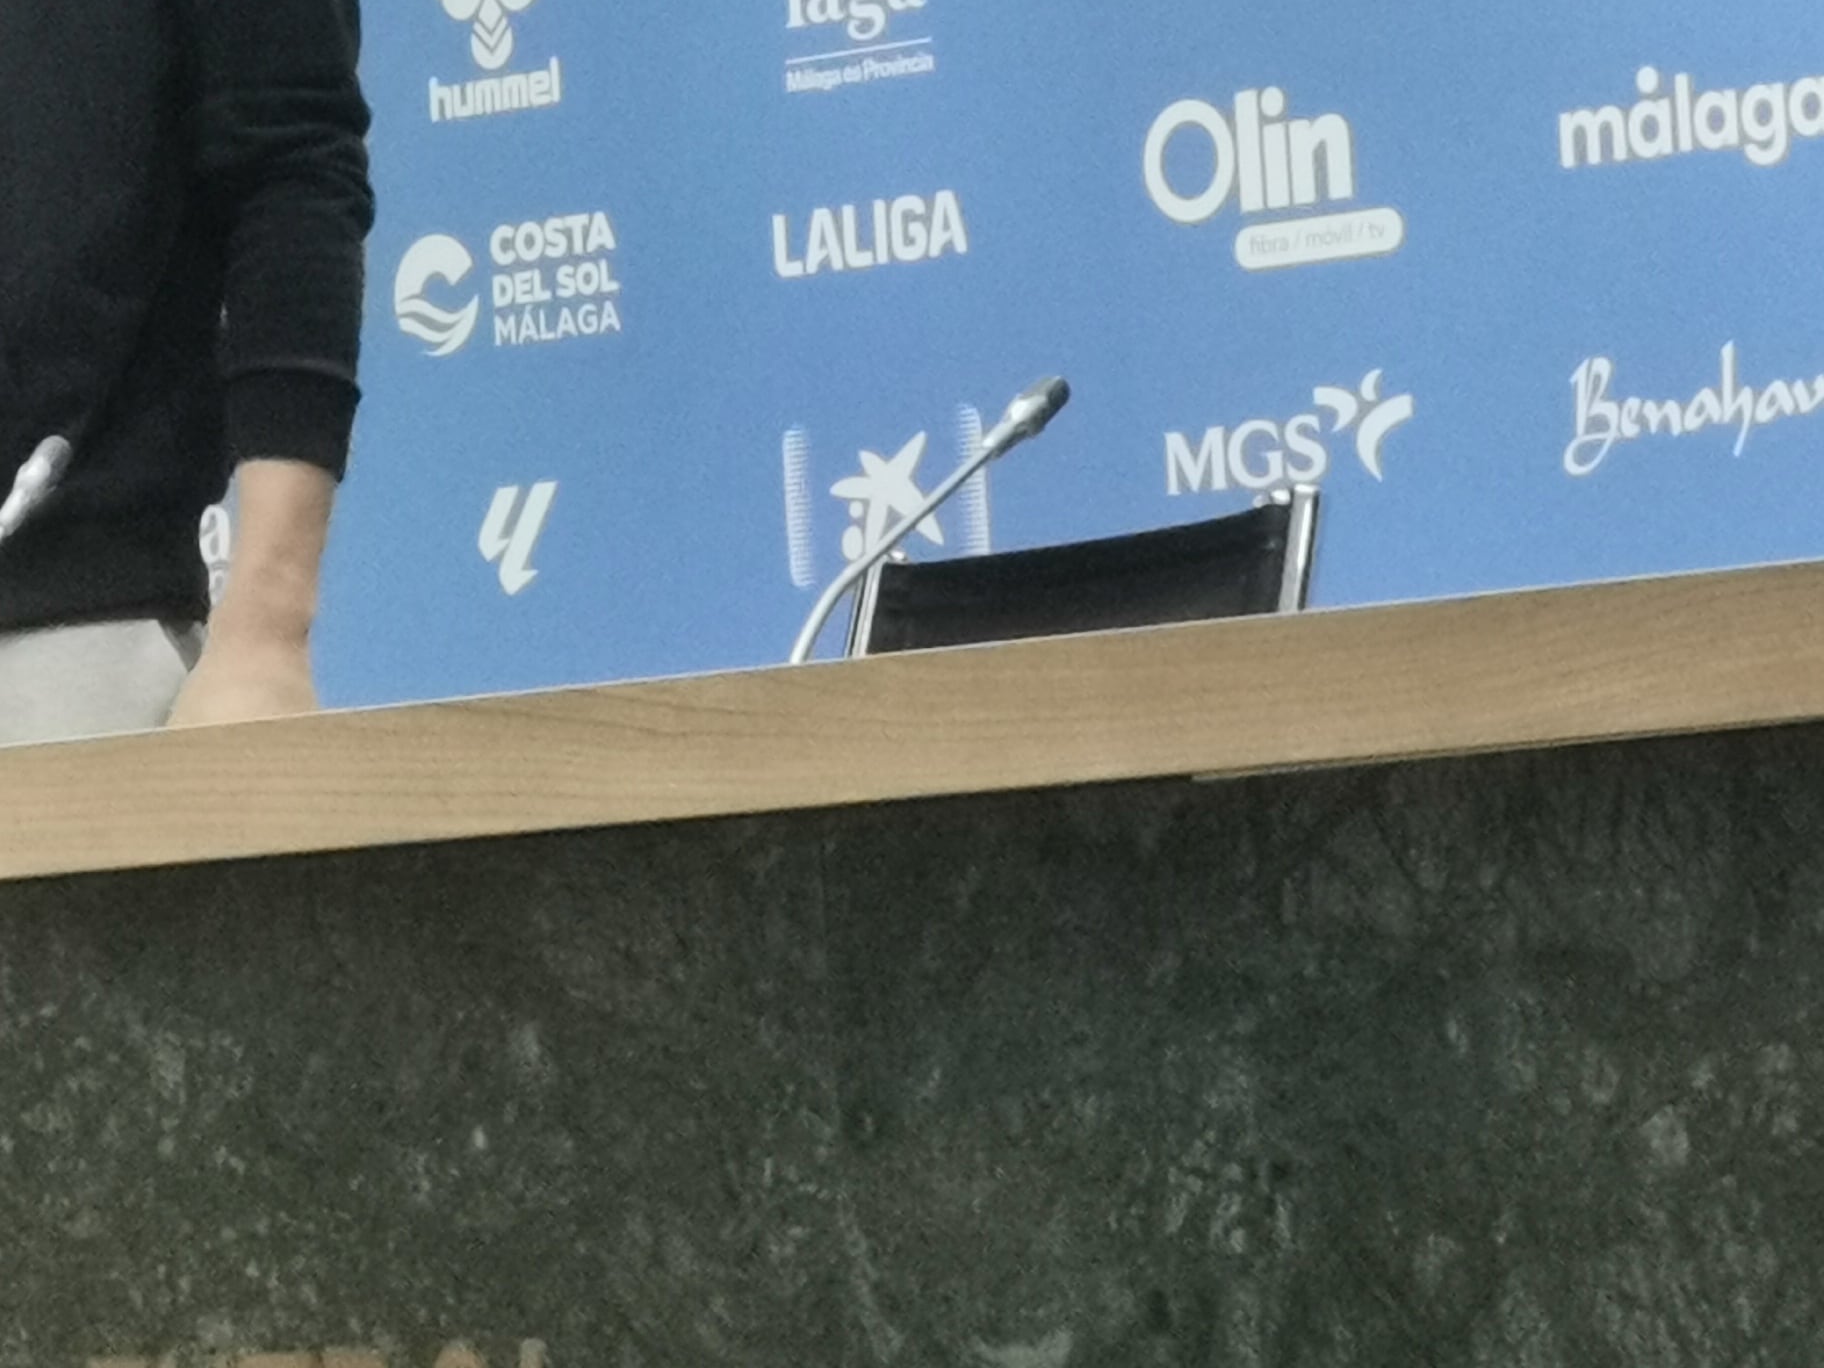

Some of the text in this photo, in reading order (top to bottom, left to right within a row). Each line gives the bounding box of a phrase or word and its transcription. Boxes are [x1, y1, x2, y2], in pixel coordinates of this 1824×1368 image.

[429, 56, 562, 124] hummel
[1143, 85, 1354, 224] Olin
[490, 211, 616, 266] COSTA
[771, 188, 968, 280] LALIGA
[492, 258, 621, 308] DEL SOL
[494, 300, 621, 346] MÁLAGA
[1564, 339, 1824, 476] Benahav
[1164, 414, 1327, 497] MGS
